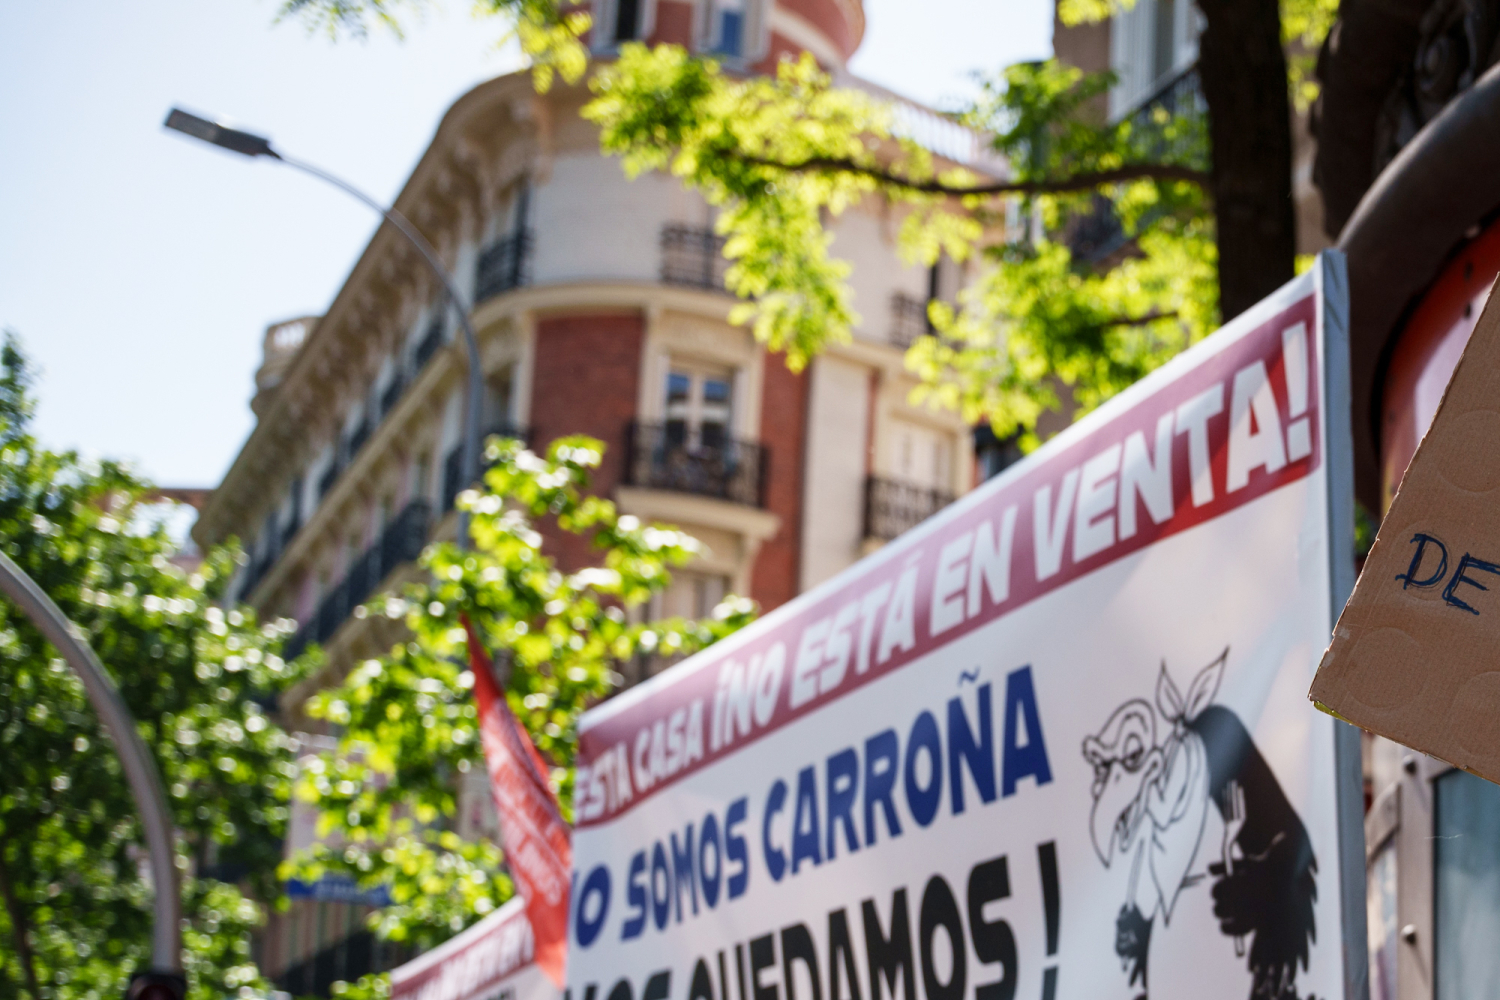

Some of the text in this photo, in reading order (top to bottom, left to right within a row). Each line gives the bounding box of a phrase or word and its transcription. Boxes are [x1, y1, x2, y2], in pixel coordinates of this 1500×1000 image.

[634, 699, 704, 792] CASA
[711, 641, 789, 752] ¡NO
[789, 556, 923, 708] ESTÁ
[930, 503, 1017, 635] EN
[1033, 320, 1313, 582] VENTA!
[567, 862, 612, 949] O
[621, 798, 749, 941] SOMOS
[762, 664, 1052, 884] CARROÑA
